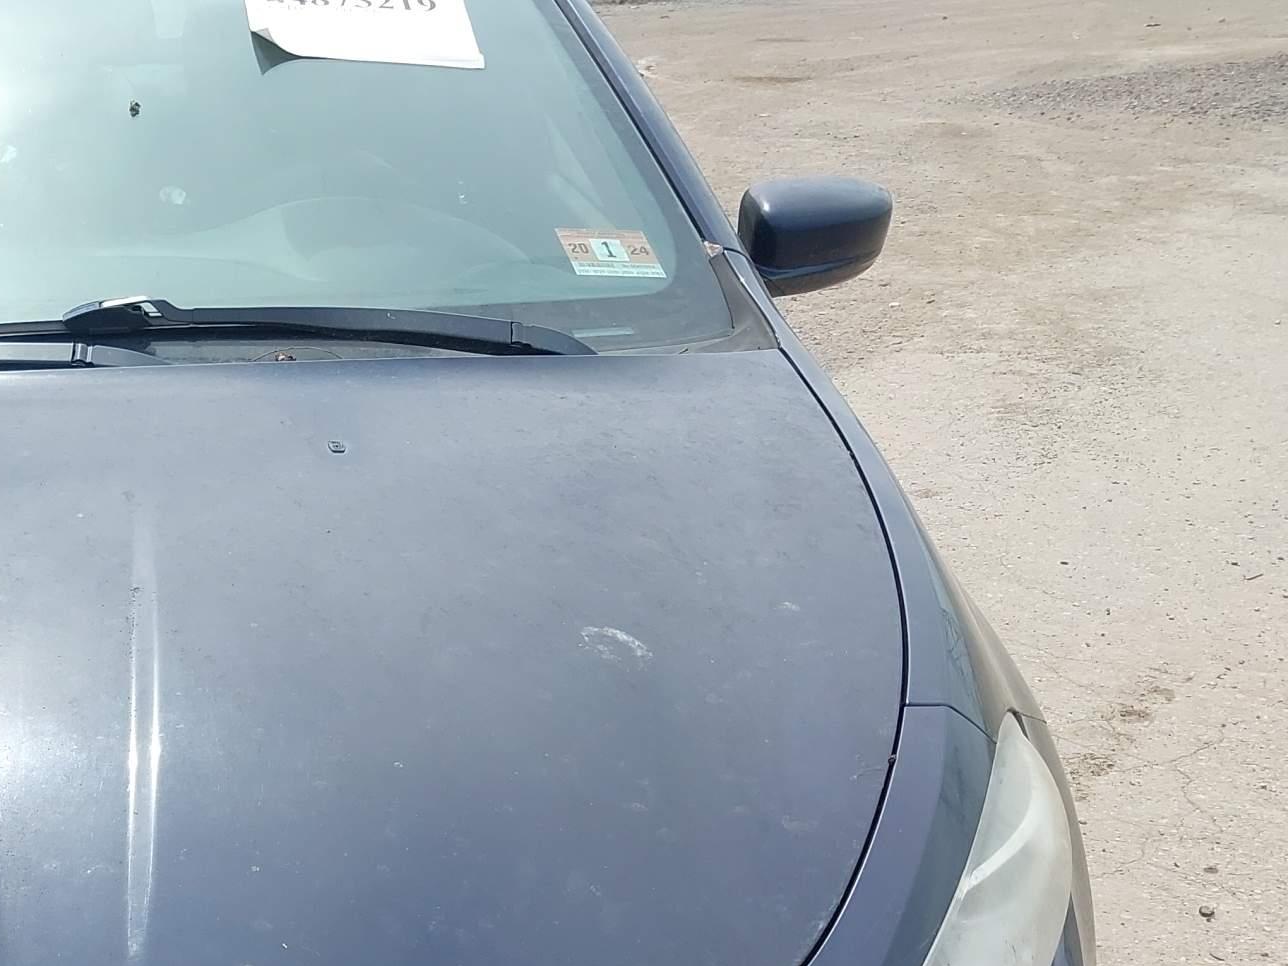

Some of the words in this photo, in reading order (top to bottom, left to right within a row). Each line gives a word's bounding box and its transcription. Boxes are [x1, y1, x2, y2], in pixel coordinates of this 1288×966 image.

[568, 242, 590, 254] 20
[601, 241, 617, 258] 1
[627, 244, 650, 256] 24
